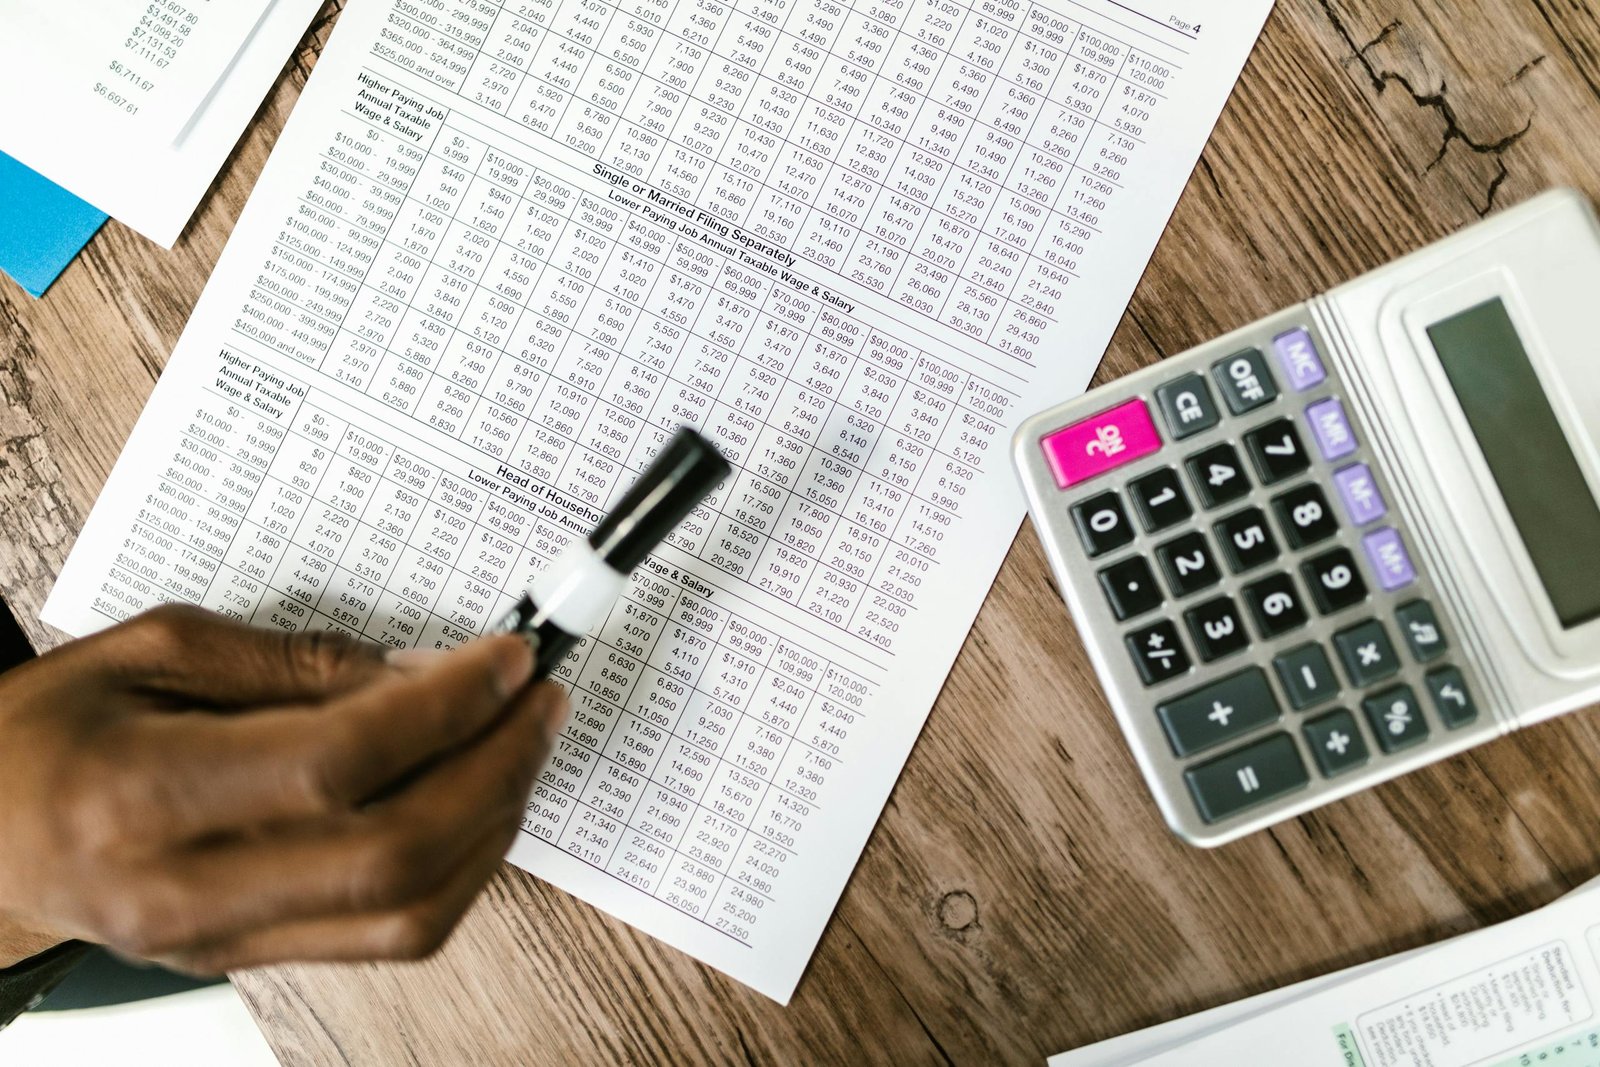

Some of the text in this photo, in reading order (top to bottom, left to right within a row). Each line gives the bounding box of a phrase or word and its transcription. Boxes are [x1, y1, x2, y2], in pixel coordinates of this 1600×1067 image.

[1167, 14, 1202, 34] Page 4
[109, 60, 155, 93] $6,711.67
[974, 17, 1157, 107] $1,020 $1,100 $1,870 $1,870
[356, 71, 445, 121] Higher Paying Job
[356, 87, 431, 130] Annual Taxable
[805, 12, 1128, 166] 3,490 4,490 5,490 6,490 7,490 8,260 8,260
[352, 100, 424, 142] Wage & Salary
[371, 41, 1033, 361] $525,000 and over 3,140 6,840 10,200 12,900 15,530 18,030 20,530 23,030 25,530 28,030 30,300 31,800
[591, 162, 797, 268] Single or Married Filing Separately
[607, 188, 856, 314] Lower Paying Job Annual Taxable Wage & Salary
[440, 164, 996, 436] $440 $940 $1,020 $1,020 $1,410 $1,870 $1,870 $1,870 $1,870 $2,030 $2,040 $2,040
[217, 348, 305, 398] Higher Paying Job
[1229, 358, 1264, 400] OFF
[1287, 341, 1315, 377] MC
[213, 377, 284, 420] Wage & Salary
[218, 364, 292, 407] Annual Taxable
[1175, 391, 1202, 422] CE
[233, 317, 599, 504] $450,000 and over 3,140 6,250 8,830 11,330 13,830 15,790
[1320, 411, 1347, 443] MR
[1264, 435, 1295, 454] 7
[495, 464, 604, 525] Head of Househol
[1149, 487, 1175, 505] 1
[1208, 464, 1235, 485] 4
[310, 447, 514, 555] $0 $820 $930 $1,020 $1,020
[467, 468, 594, 538] Lower Paying Job Annua
[1090, 509, 1117, 531] 0
[1293, 500, 1322, 526] 8
[1233, 525, 1264, 549] 5
[669, 568, 680, 581] &
[679, 573, 715, 599] Salary
[1175, 550, 1204, 575] 2
[1321, 565, 1351, 588] 9
[709, 552, 892, 648] 20,290 21,790 23,100 24,400
[1263, 592, 1292, 615] 6
[1204, 615, 1233, 639] 3
[624, 603, 855, 725] $1,870 $1,870 $1,910 $2,040 $2,040
[573, 710, 802, 832] 12,690 13,690 14,690 15,670 16,770
[567, 840, 749, 940] 23,110 24,610 26,050 27,350
